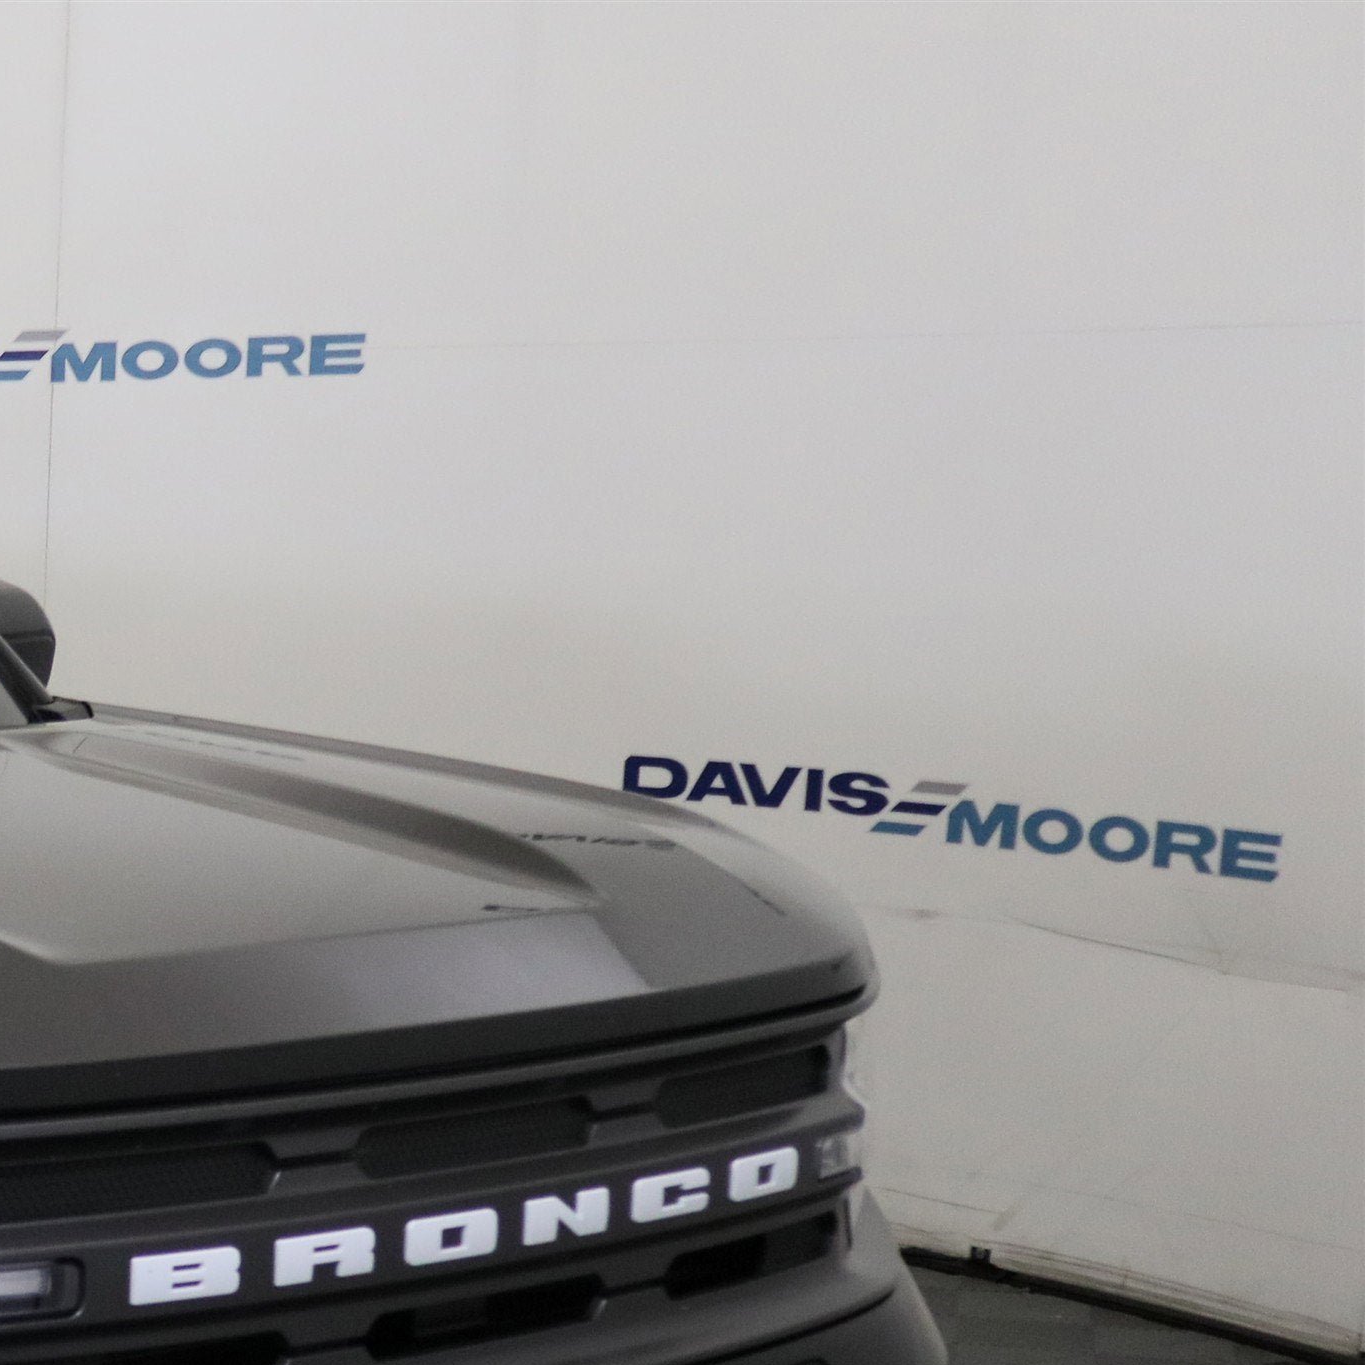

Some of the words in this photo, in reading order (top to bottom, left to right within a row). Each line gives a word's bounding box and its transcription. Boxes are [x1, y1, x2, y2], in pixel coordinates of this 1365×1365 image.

[50, 333, 366, 382] MOORE
[623, 755, 892, 816] DAVIS
[946, 800, 1282, 882] MOORE
[128, 1146, 799, 1306] BRONCO
